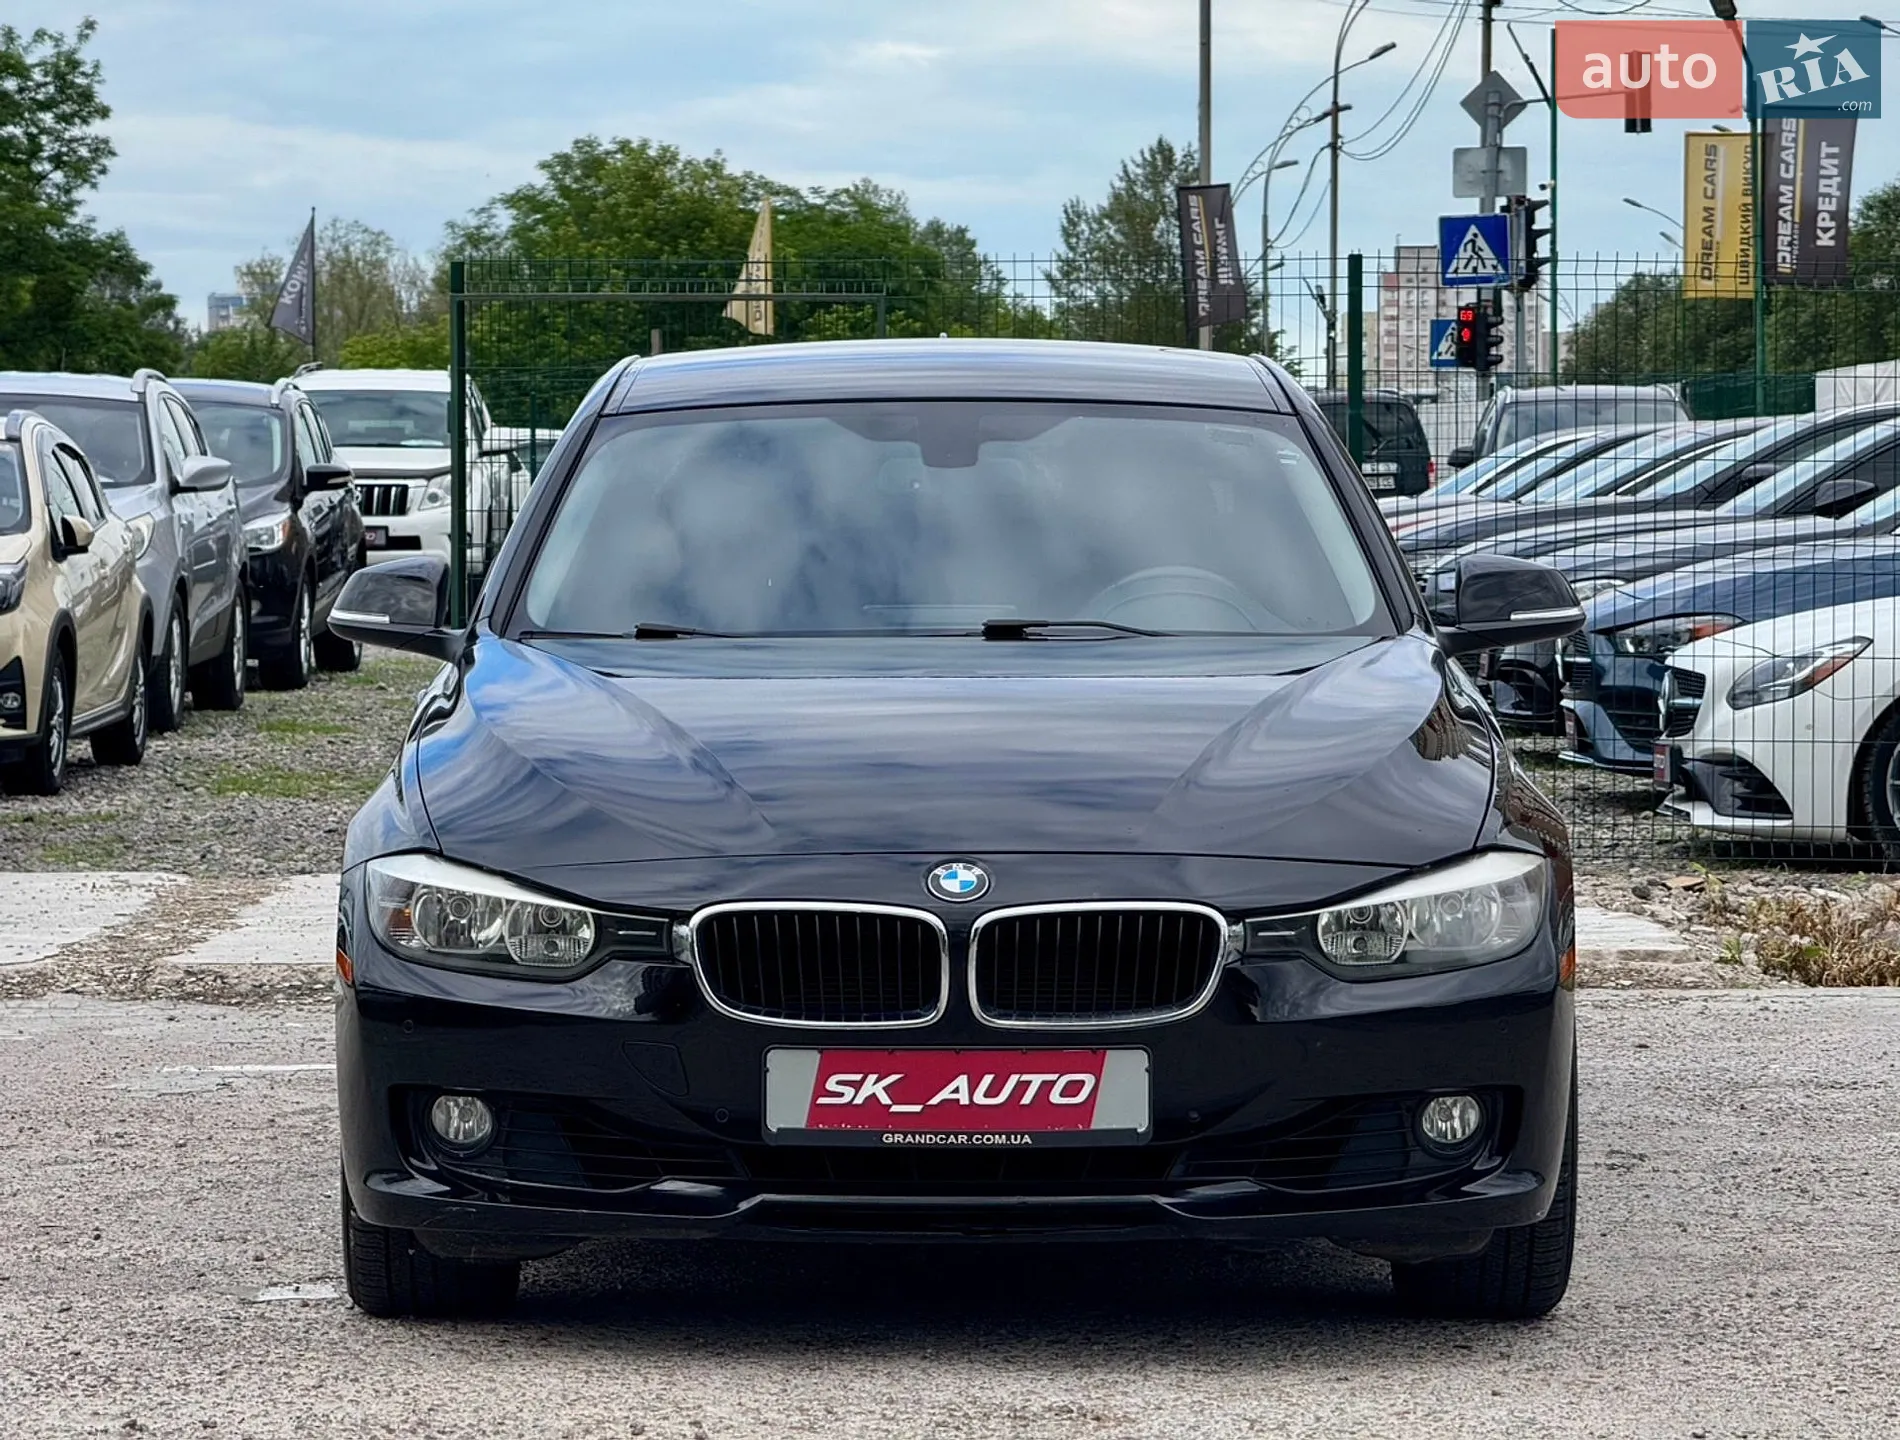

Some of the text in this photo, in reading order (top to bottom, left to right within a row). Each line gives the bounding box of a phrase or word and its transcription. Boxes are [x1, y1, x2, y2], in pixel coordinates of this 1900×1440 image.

[1187, 194, 1203, 246] CARS
[1700, 143, 1718, 281] DREAM CARS
[1776, 118, 1797, 272] DREAM CARS
[1815, 141, 1842, 247] КРЕДИТ
[1738, 204, 1753, 285] ШВИДКИЙ
[933, 862, 984, 875] BMW
[815, 1073, 1097, 1113] SK_AUTO
[881, 1132, 1033, 1146] GRANDCAR.COM.UA
